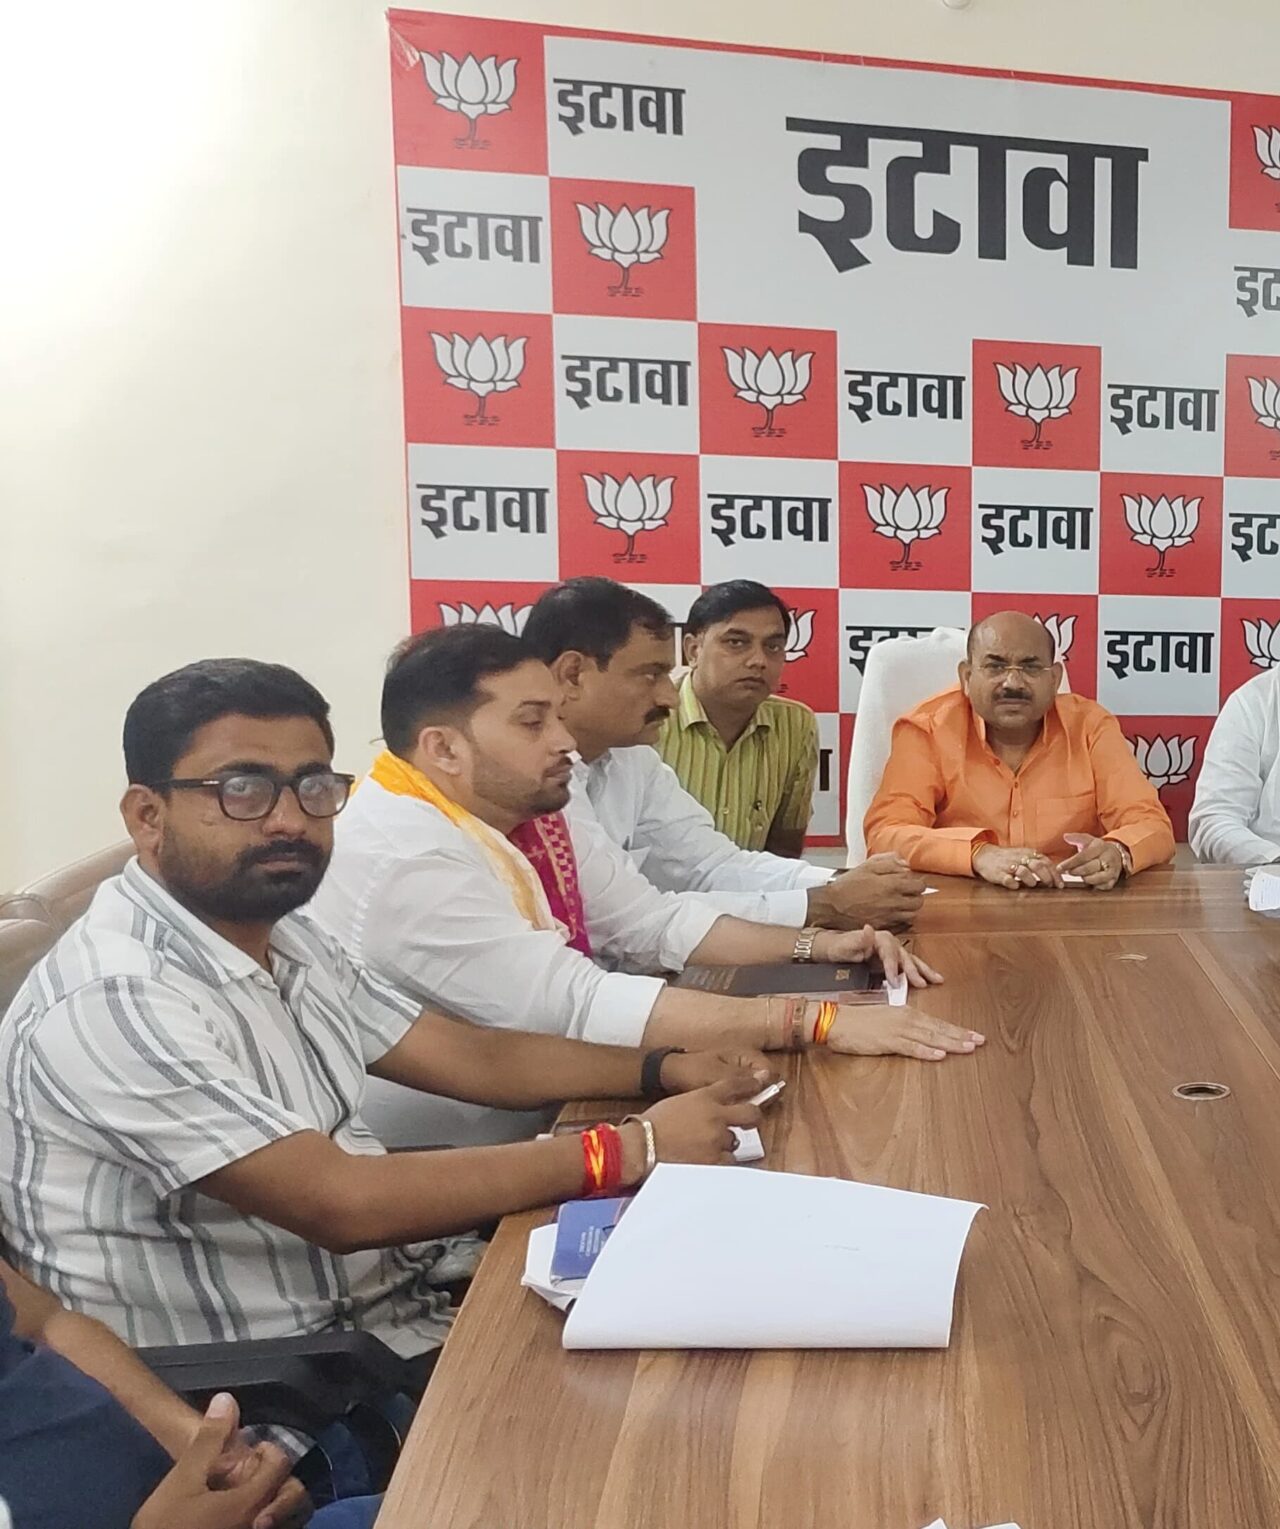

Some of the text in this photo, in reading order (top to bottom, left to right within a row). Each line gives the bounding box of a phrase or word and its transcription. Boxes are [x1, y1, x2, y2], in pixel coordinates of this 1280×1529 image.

[553, 78, 685, 136] इटावा
[786, 116, 1149, 273] इटावा
[406, 207, 543, 266] इटावा
[561, 355, 691, 410] इटावा
[845, 370, 965, 423] इटावा
[1108, 384, 1219, 435] इटावा
[416, 484, 549, 539] इटावा
[708, 494, 832, 547] इटावा
[978, 504, 1093, 555] इटावा
[1104, 631, 1214, 679] इटावा
